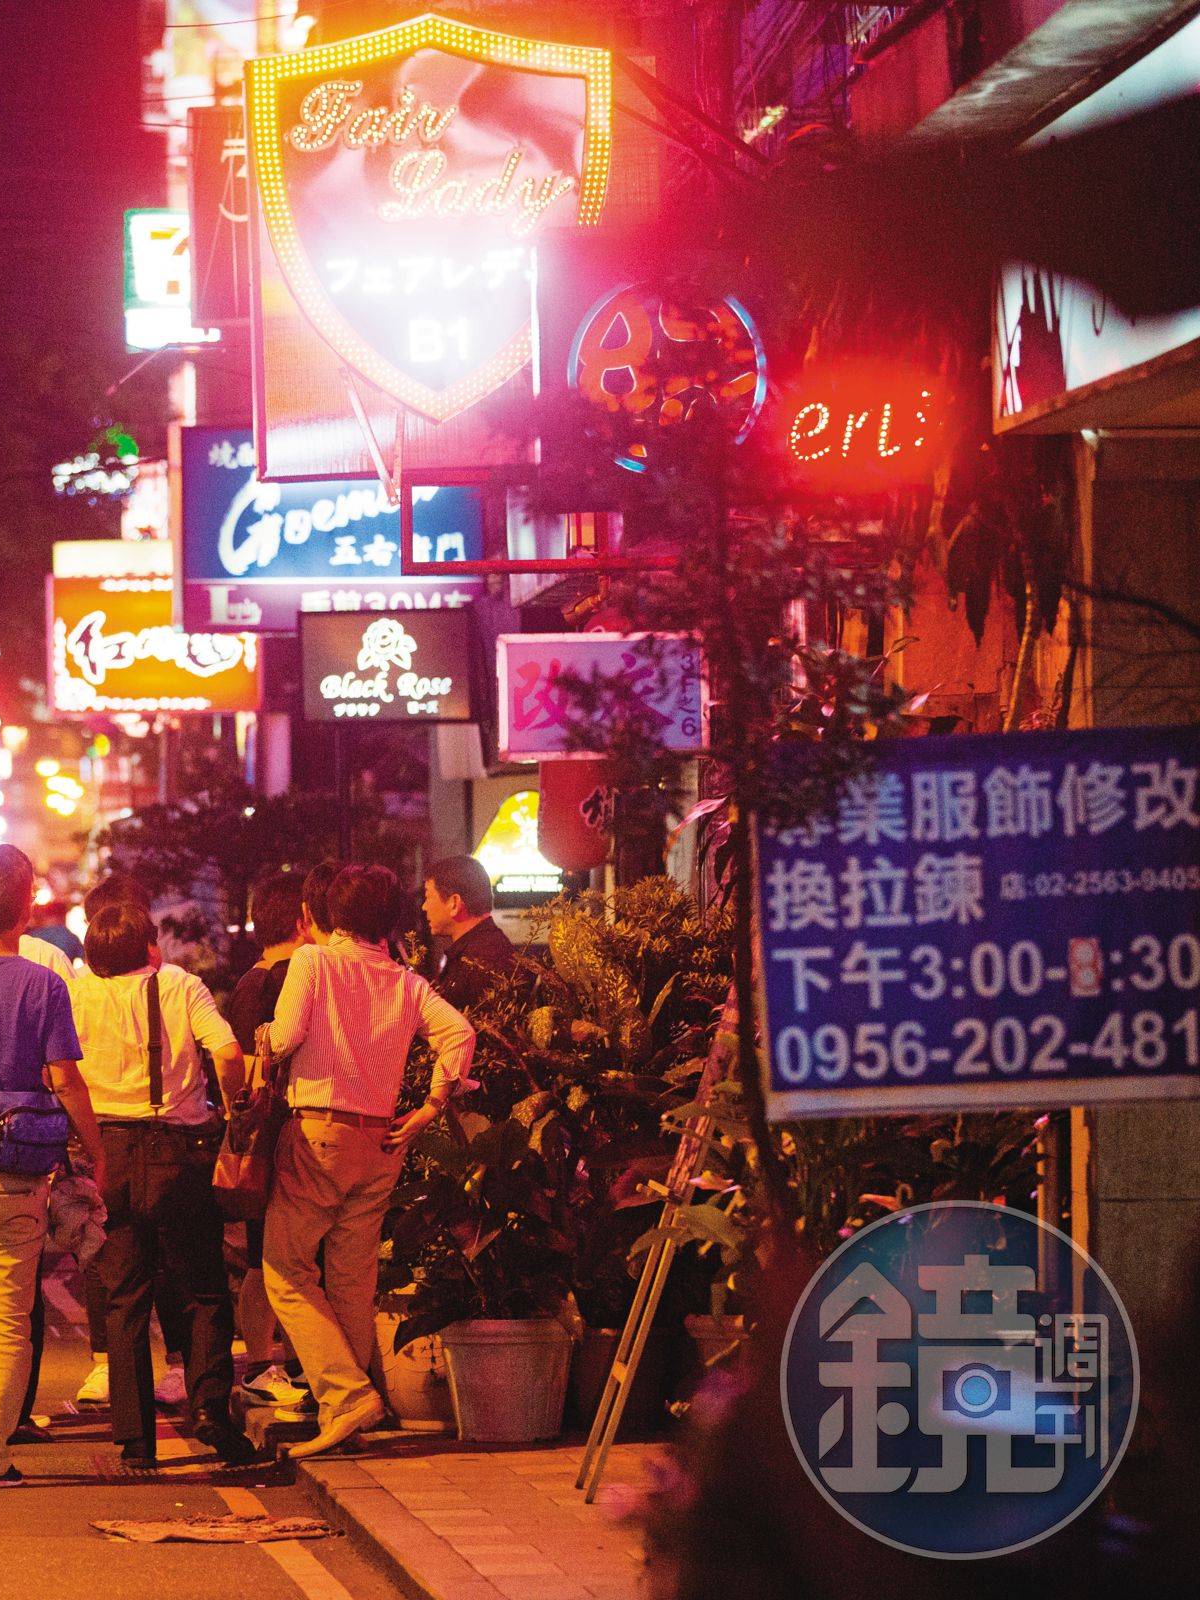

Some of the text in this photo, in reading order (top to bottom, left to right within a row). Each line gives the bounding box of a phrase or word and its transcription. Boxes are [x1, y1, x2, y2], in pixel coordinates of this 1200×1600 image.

[290, 80, 458, 149] Fair
[380, 145, 576, 236] Lady
[324, 246, 537, 295] フェアレデ
[408, 316, 470, 364] B1
[320, 671, 453, 703] Black Rose
[775, 1008, 1200, 1083] 0956-202-481
